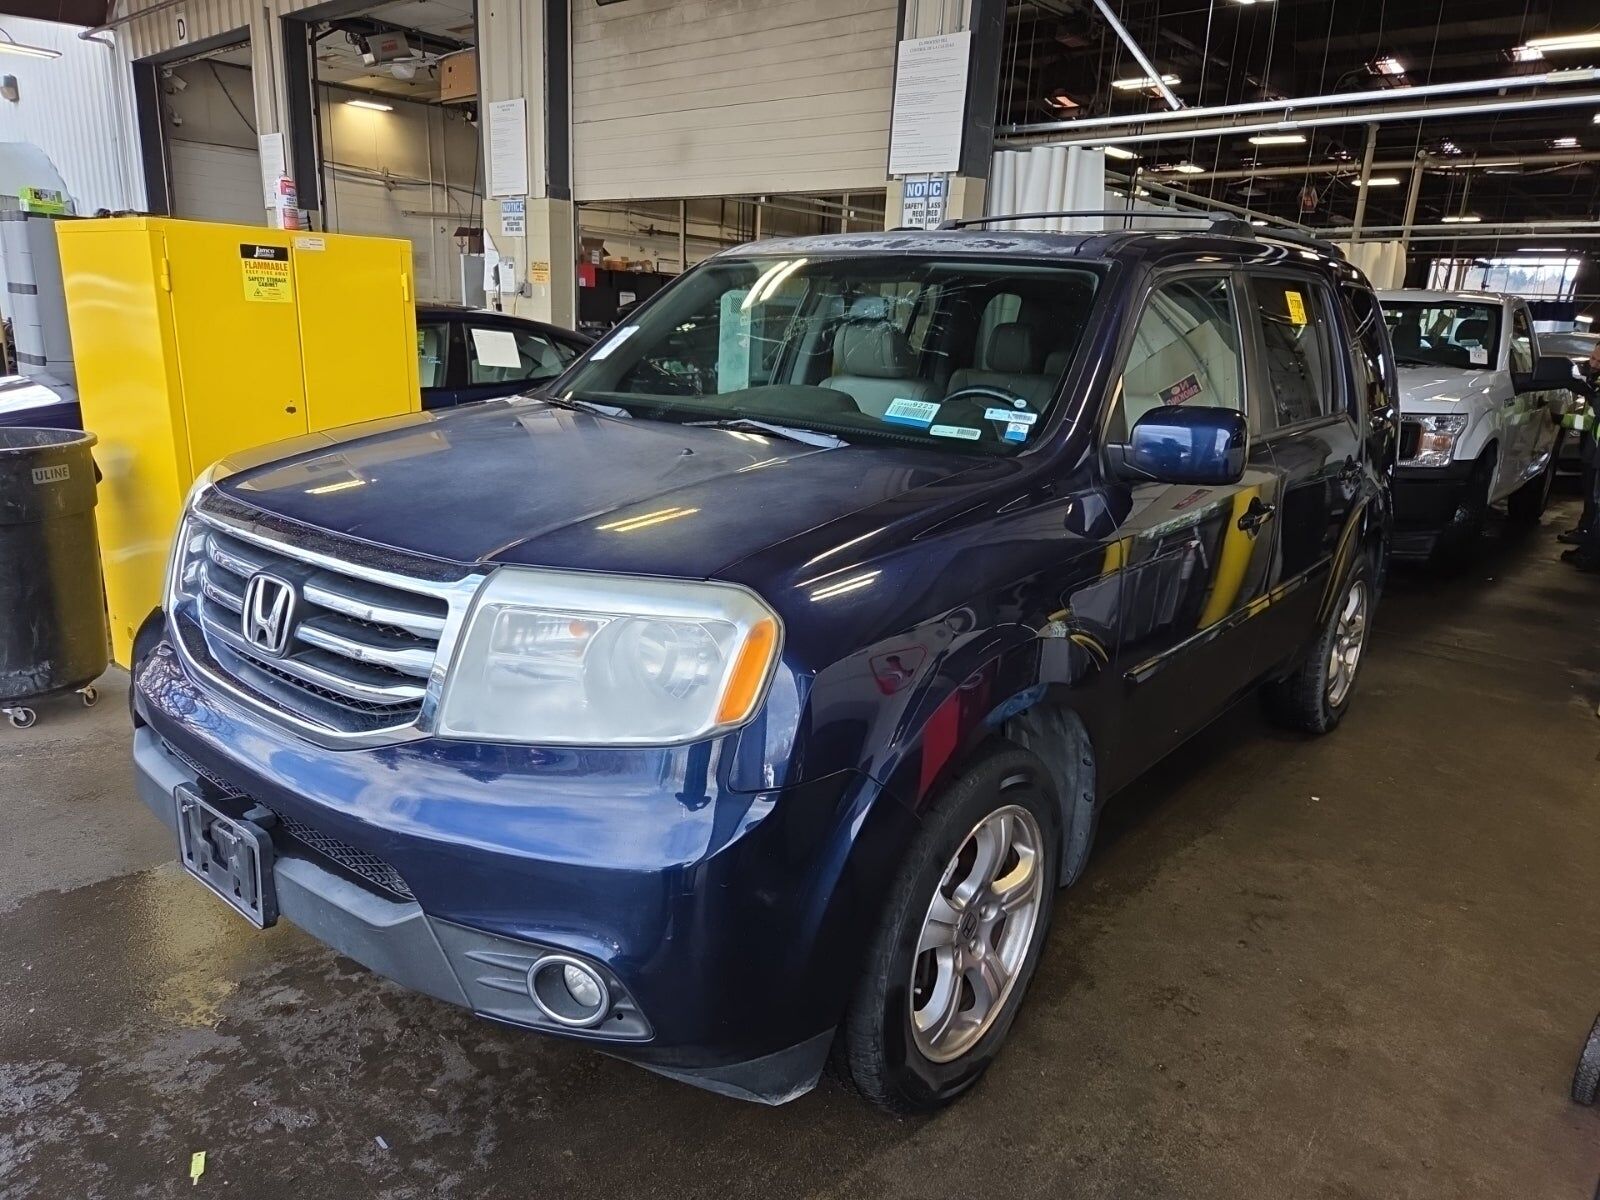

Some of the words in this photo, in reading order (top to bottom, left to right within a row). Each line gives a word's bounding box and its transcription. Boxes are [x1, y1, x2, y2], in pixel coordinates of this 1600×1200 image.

[177, 18, 186, 40] D
[906, 182, 944, 197] NOTIC
[502, 202, 524, 211] NOTICE
[912, 209, 938, 217] REQRED
[253, 246, 275, 258] Jamco
[244, 261, 288, 271] FLAMMABLE
[34, 467, 68, 481] ULINE
